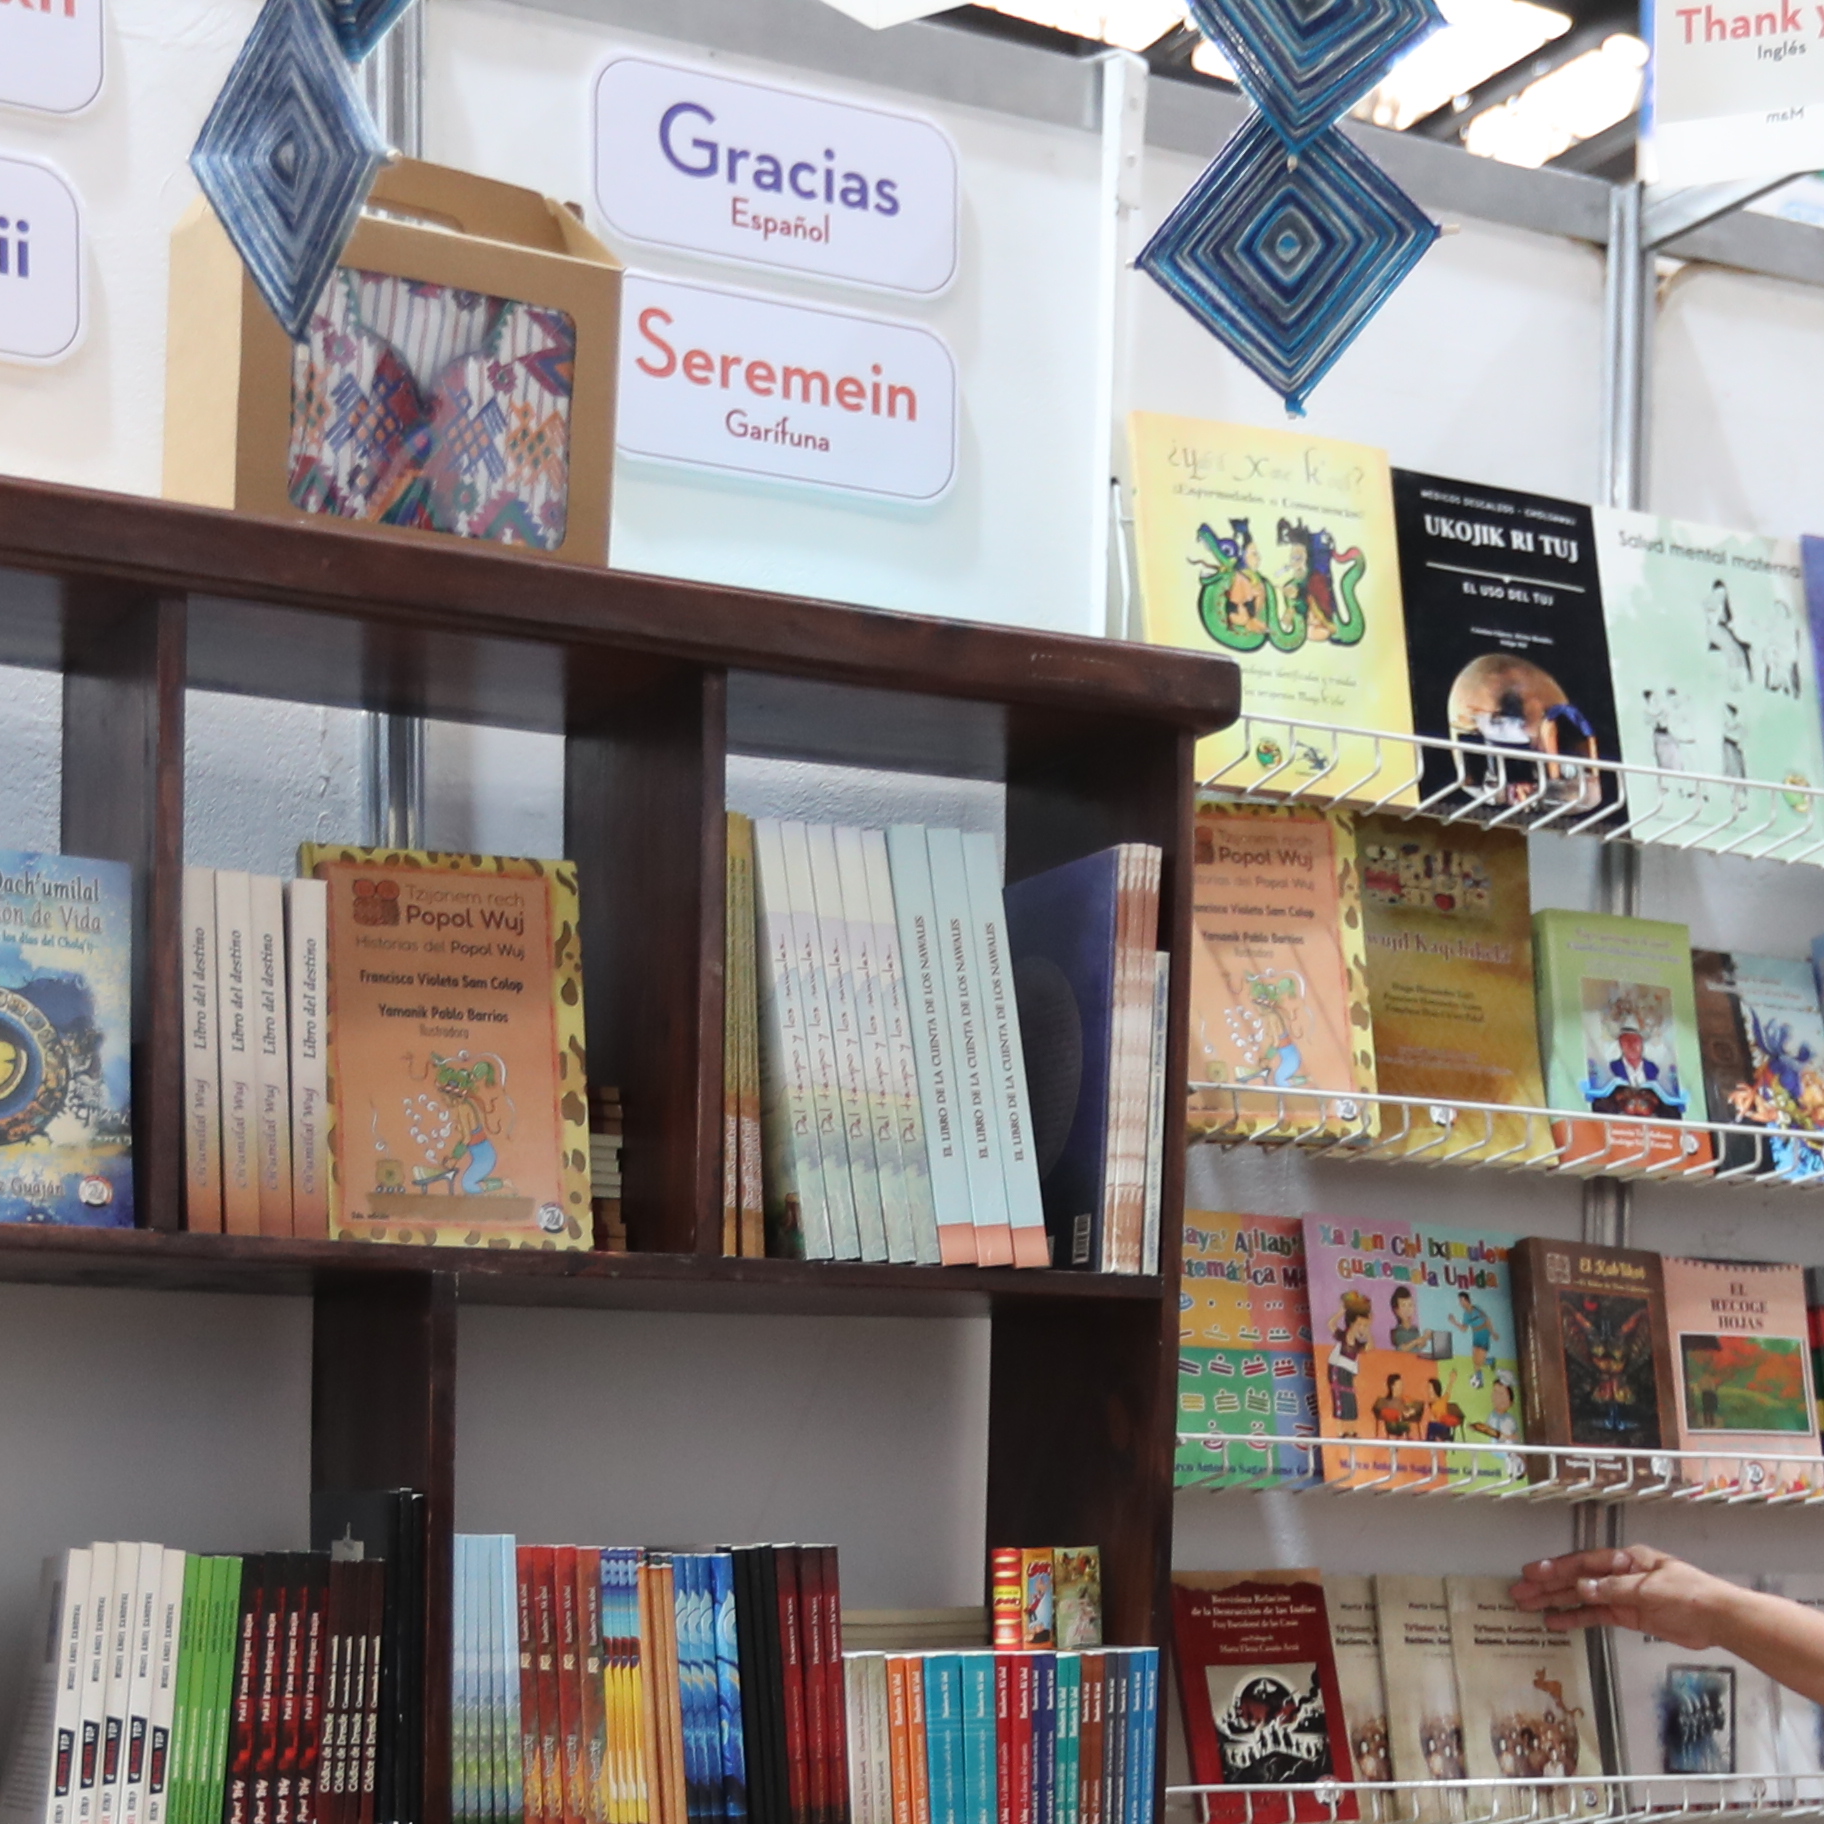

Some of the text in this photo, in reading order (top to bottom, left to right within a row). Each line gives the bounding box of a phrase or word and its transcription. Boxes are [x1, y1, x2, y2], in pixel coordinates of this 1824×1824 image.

[1676, 0, 1803, 44] Thank
[1757, 40, 1807, 61] Inglés
[658, 101, 900, 217] Gracias
[732, 197, 831, 244] Español
[635, 307, 918, 421] Seremein
[725, 408, 831, 450] Garífuna
[1423, 513, 1580, 564] UKOJIK RI TUJ
[1618, 530, 1663, 554] Salud
[1669, 541, 1727, 567] mental
[1218, 847, 1313, 871] Popol Wuj
[31, 906, 52, 929] de
[59, 907, 103, 932] Vida
[405, 903, 525, 936] Popol Wuj
[191, 927, 207, 981] destino
[450, 939, 492, 959] Popol
[496, 942, 525, 961] Wuj
[913, 915, 929, 970] NAWALES
[192, 983, 207, 1009] del
[920, 972, 933, 995] LOS
[923, 998, 936, 1015] DE
[192, 1011, 208, 1051] Libro
[925, 1017, 942, 1067] CUENTA
[934, 1087, 946, 1105] DE
[937, 1107, 951, 1142] LIBRO
[942, 1145, 953, 1158] EL
[1336, 1257, 1498, 1290] Guatemala Unida
[1729, 1282, 1748, 1298] EL
[1710, 1298, 1768, 1315] RECOGE
[1717, 1315, 1764, 1331] HOJAS
